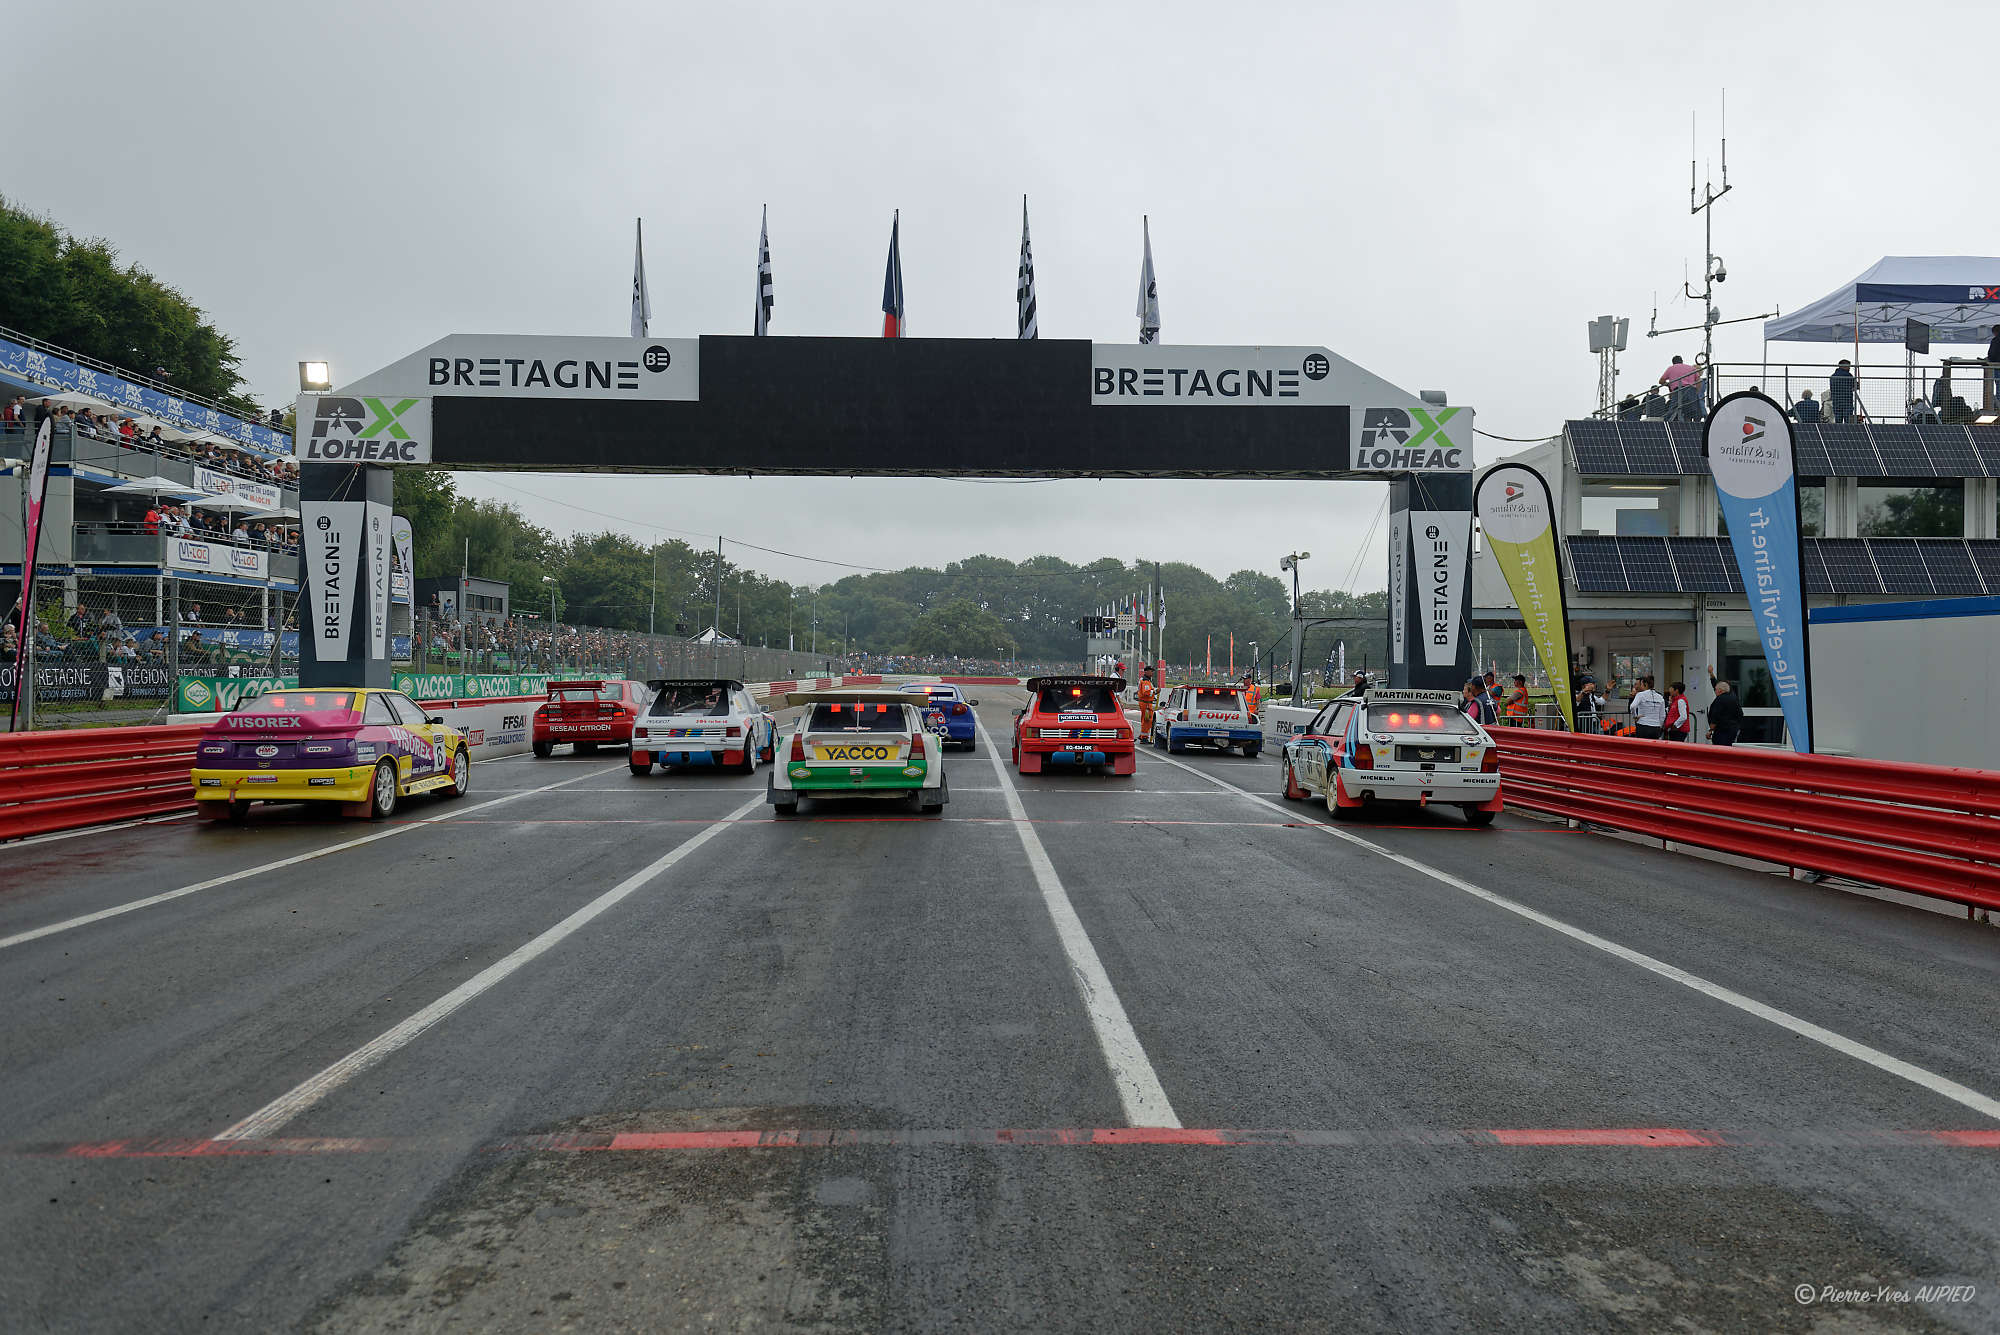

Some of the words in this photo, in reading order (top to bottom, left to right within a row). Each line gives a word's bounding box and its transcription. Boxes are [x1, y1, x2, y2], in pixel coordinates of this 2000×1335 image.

[646, 352, 668, 367] BE
[1305, 360, 1327, 375] BE
[428, 357, 639, 390] BRETAGNE
[1094, 367, 1299, 397] BRETAGNE
[312, 397, 421, 439] RX
[1360, 407, 1462, 447] RX
[306, 439, 419, 462] LOHEAC
[1356, 448, 1463, 469] LOHEAC
[325, 532, 340, 639] BRETAGNE
[1433, 541, 1448, 645] BRETAGNE
[37, 668, 92, 686] RETAGNE
[416, 675, 453, 698] YACCO
[479, 677, 510, 697] YACCO
[1374, 691, 1414, 699] MARTINI
[1415, 691, 1451, 700] RACING
[227, 717, 301, 728] VISOREX
[502, 715, 525, 730] FFSA
[1198, 710, 1241, 722] Fouya
[580, 723, 612, 732] CITROËN
[387, 726, 432, 761] VISOREX
[825, 746, 888, 760] YACCO
[436, 746, 444, 767] 6
